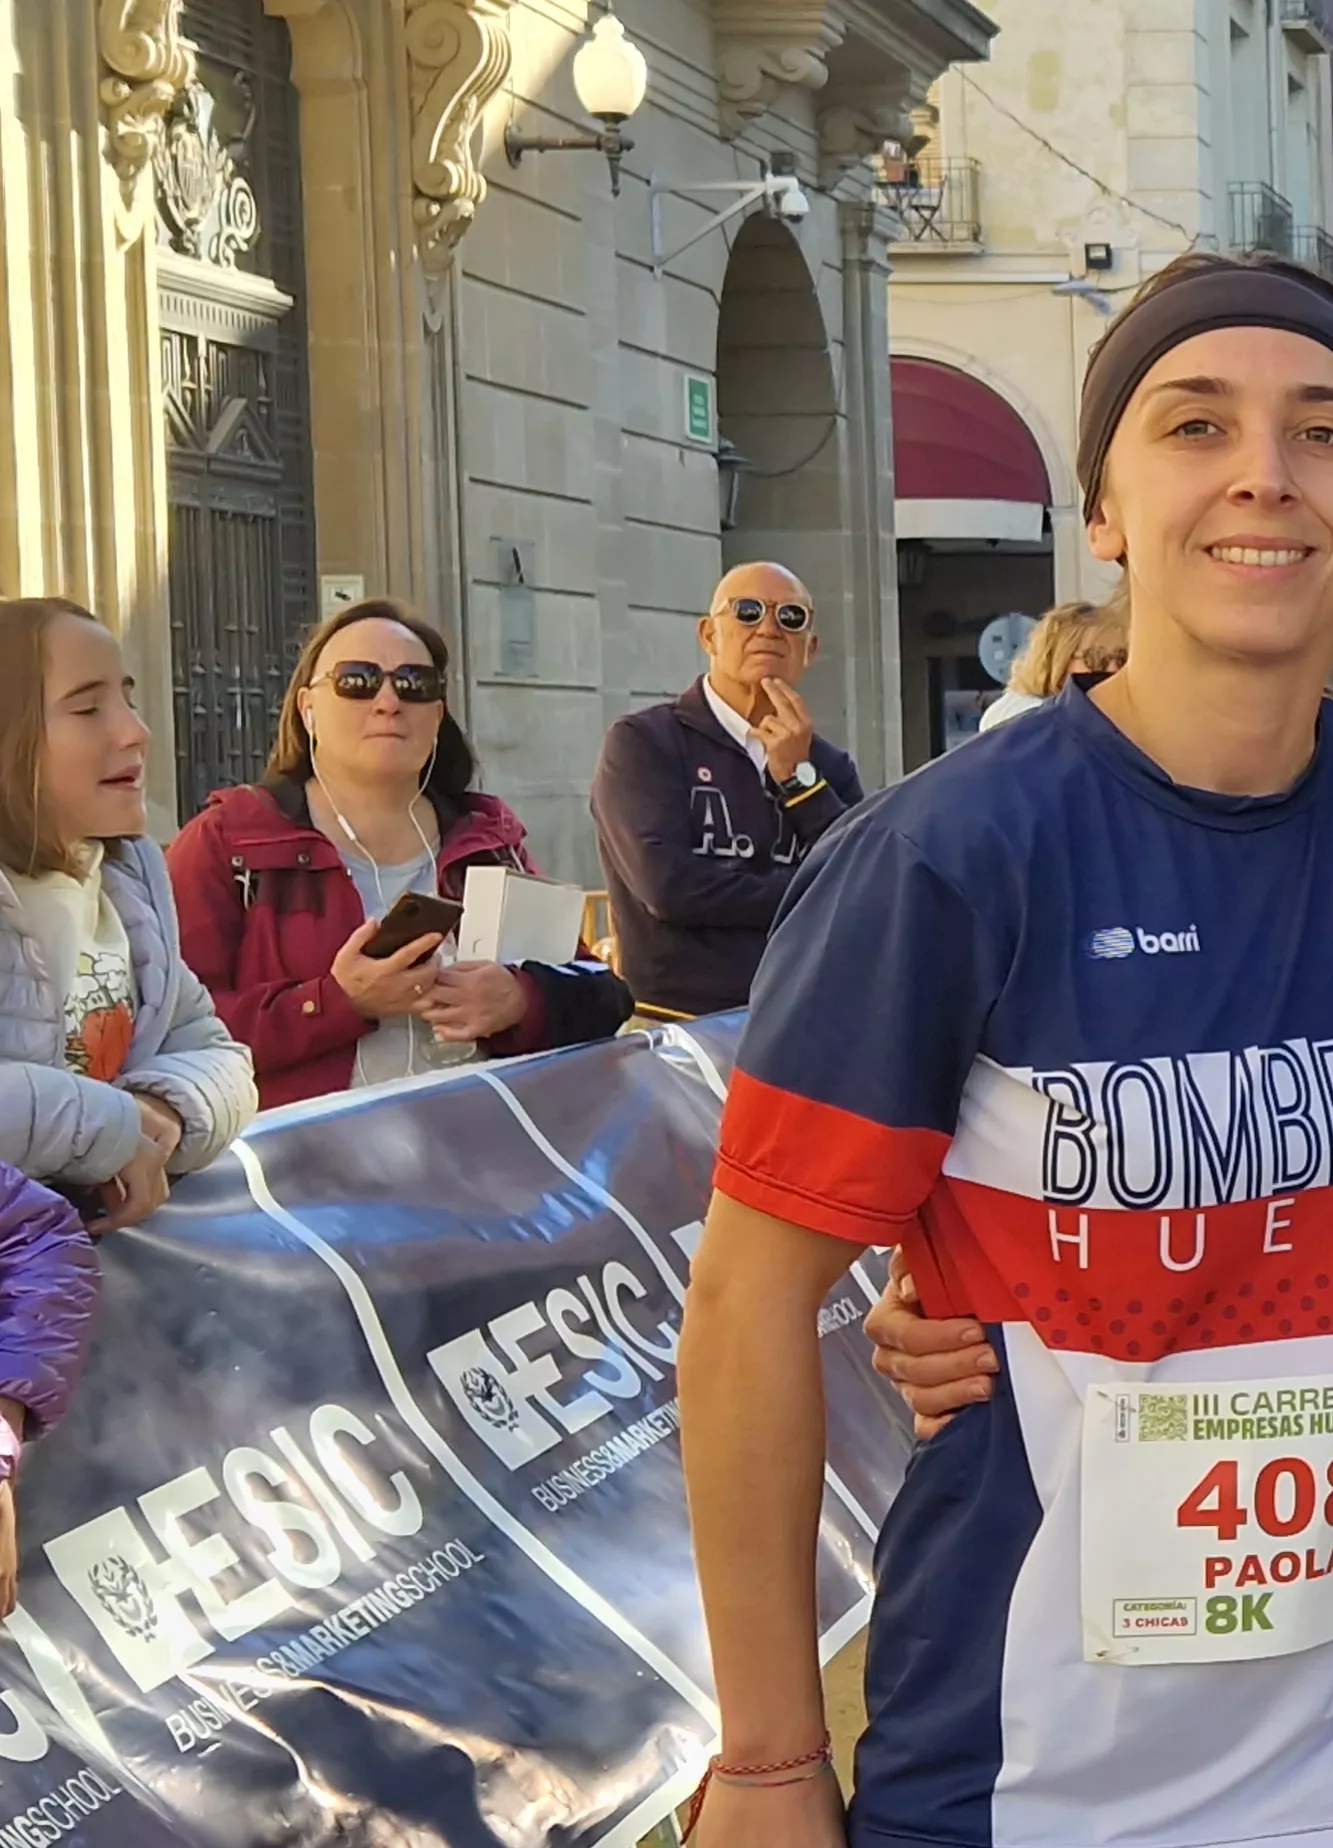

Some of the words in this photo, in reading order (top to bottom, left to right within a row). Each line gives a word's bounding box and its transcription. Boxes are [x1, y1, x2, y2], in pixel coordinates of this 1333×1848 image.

[1137, 924, 1200, 954] barri
[487, 1261, 680, 1435] ESIC
[1193, 1395, 1219, 1416] III
[1193, 1413, 1304, 1441] EMPRESAS
[137, 1404, 423, 1642] ESIC
[1122, 1618, 1131, 1628] 3
[1135, 1616, 1188, 1628] CHICAS
[1205, 1592, 1274, 1635] 8K
